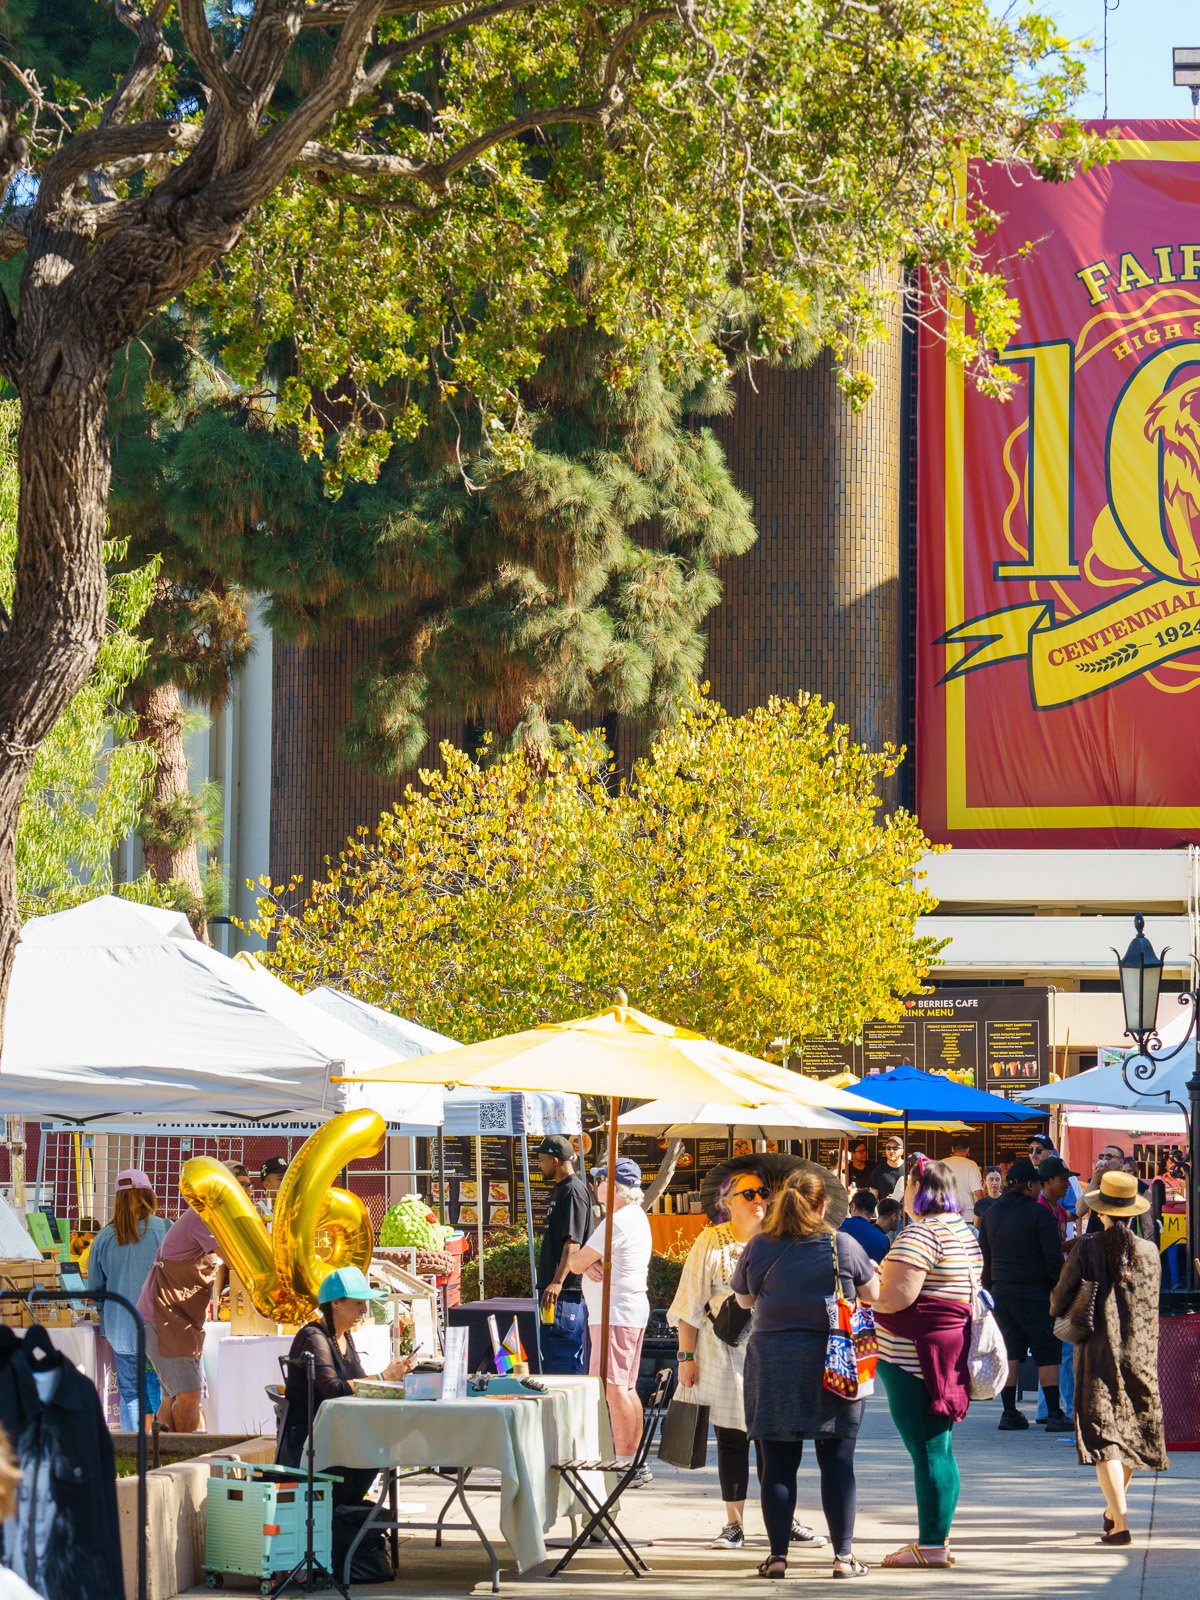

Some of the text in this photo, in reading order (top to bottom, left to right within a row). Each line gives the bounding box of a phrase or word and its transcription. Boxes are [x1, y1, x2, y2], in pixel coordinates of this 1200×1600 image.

[1112, 323, 1183, 362] HIGH
[918, 999, 979, 1008] BERRIES CAFE
[926, 1008, 955, 1017] MENU
